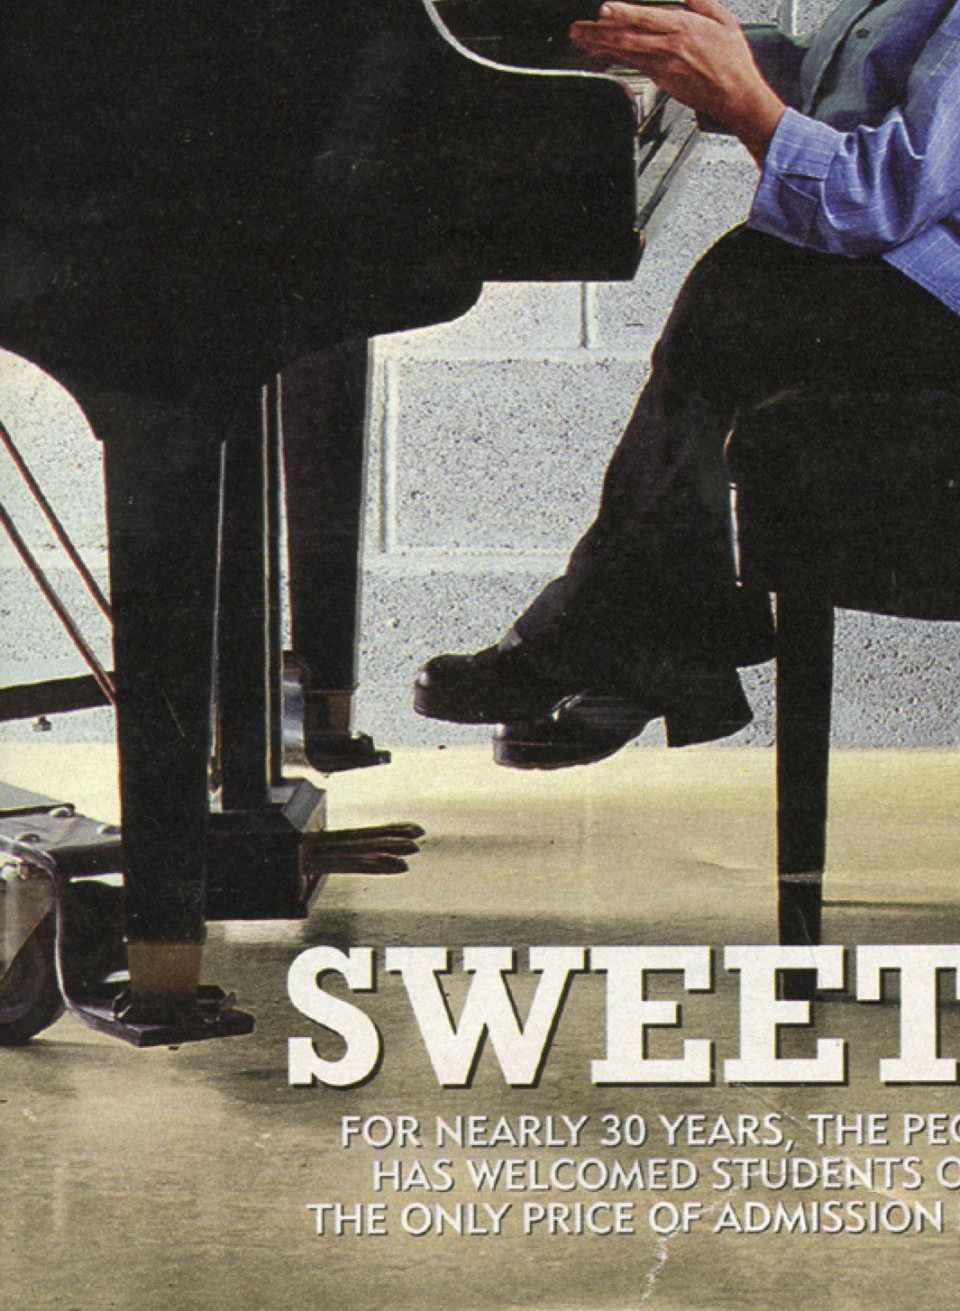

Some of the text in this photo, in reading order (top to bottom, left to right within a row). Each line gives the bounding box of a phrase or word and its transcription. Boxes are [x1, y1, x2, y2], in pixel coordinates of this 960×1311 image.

[341, 1115, 418, 1148] FOR
[436, 1115, 587, 1147] NEARLY
[601, 1115, 647, 1146] 30
[660, 1114, 794, 1153] YEARS,
[808, 1114, 885, 1146] THE
[373, 1158, 454, 1192] HAS
[466, 1158, 698, 1191] WELCOMED
[712, 1156, 922, 1189] STUDENTS
[307, 1204, 387, 1235] THE
[400, 1202, 511, 1235] ONLY
[523, 1202, 635, 1233] PRICE
[649, 1202, 704, 1233] OF
[714, 1201, 942, 1233] ADMISSION
